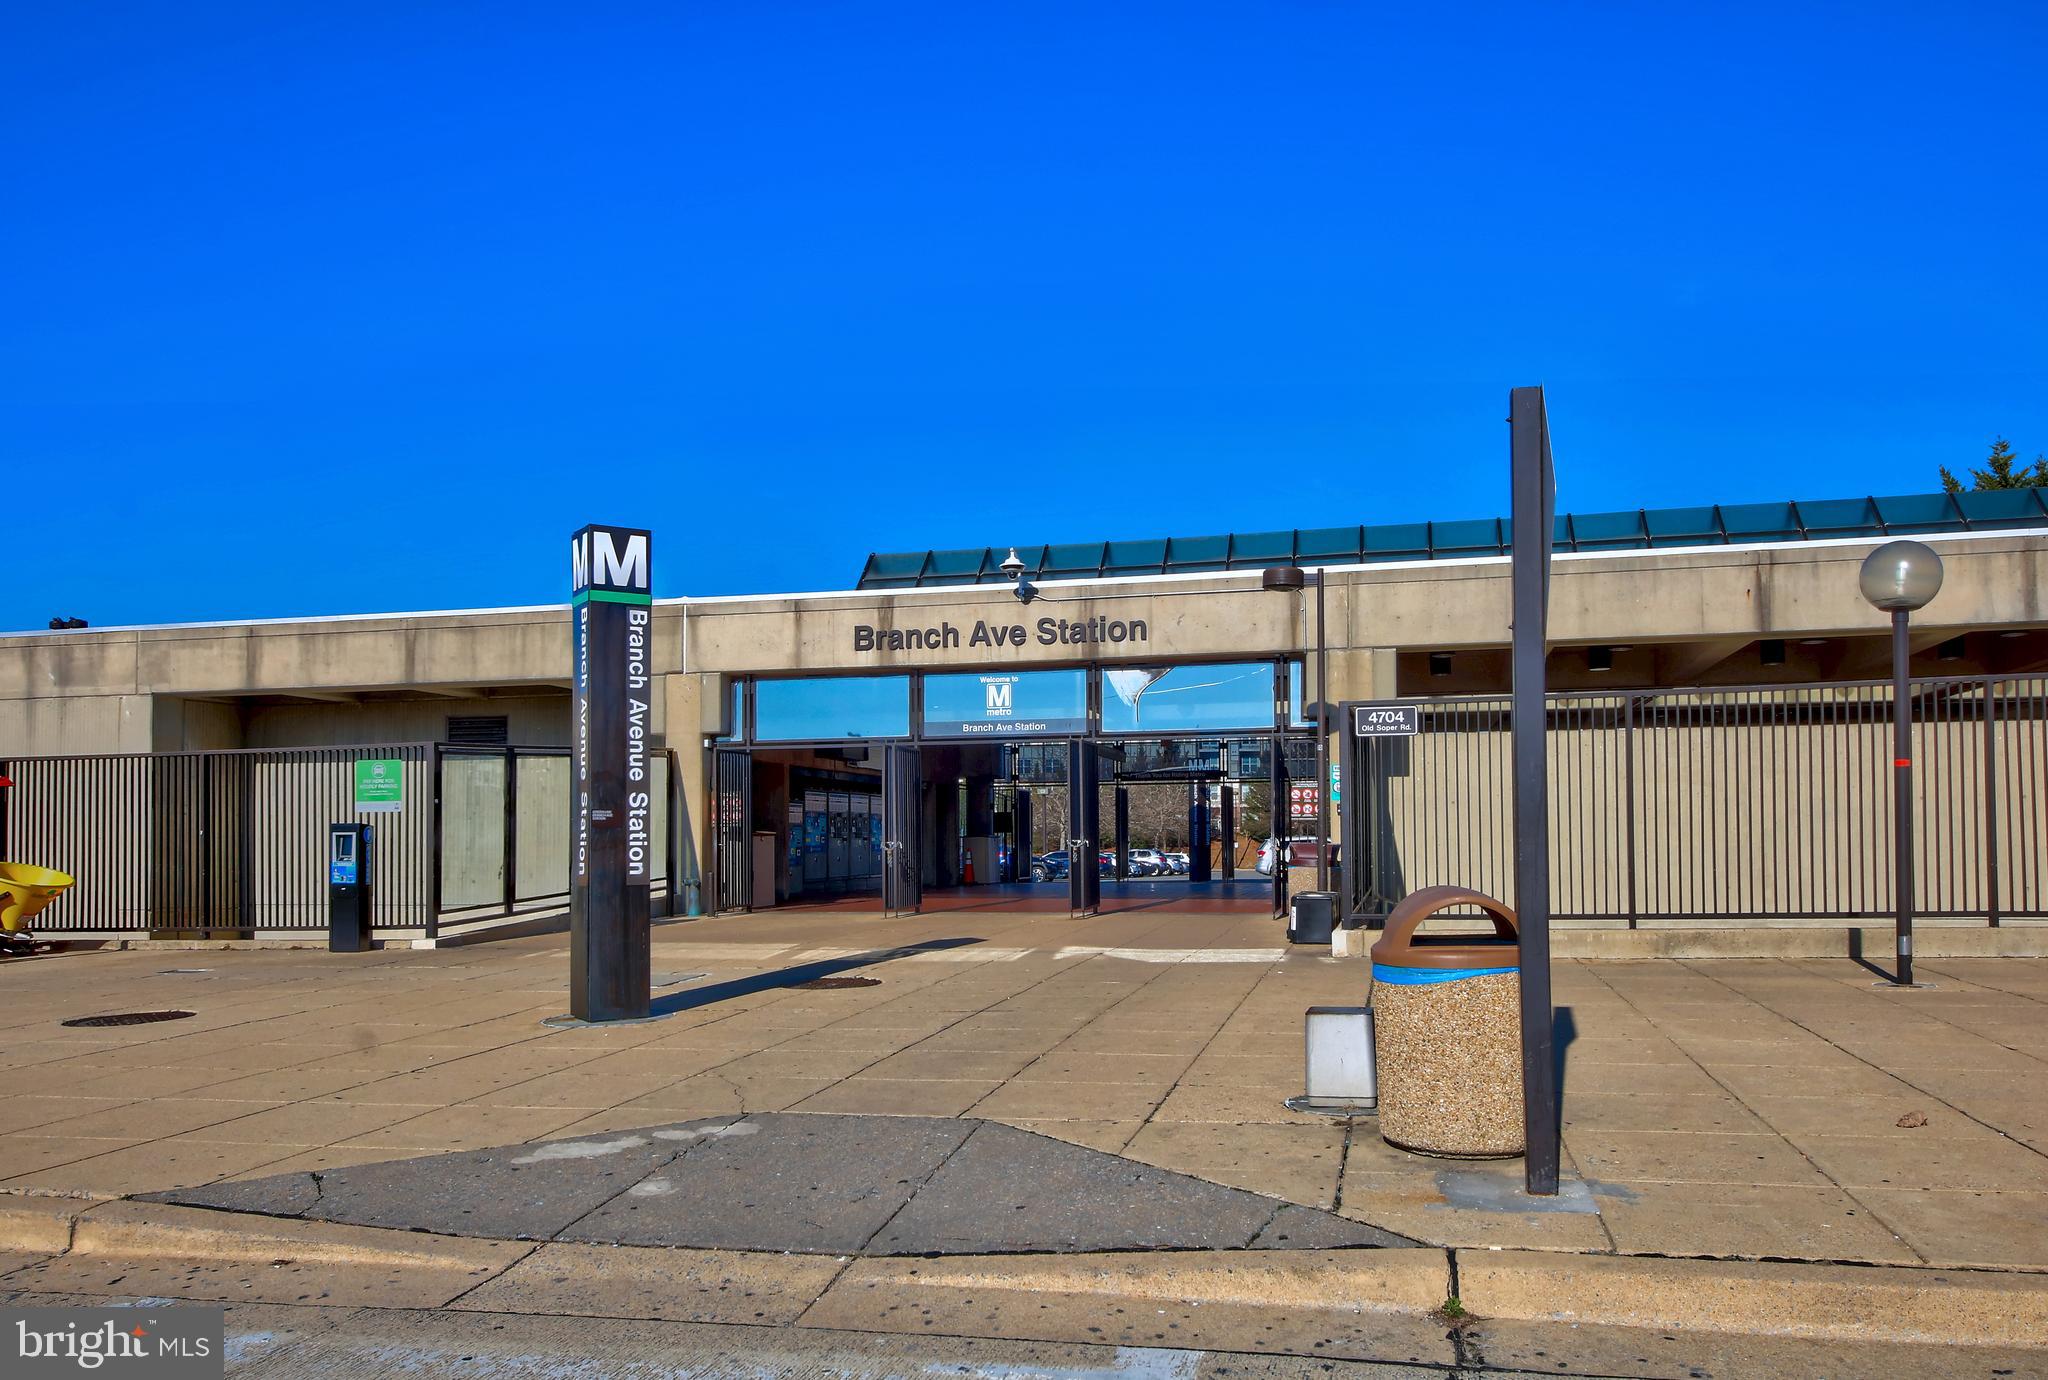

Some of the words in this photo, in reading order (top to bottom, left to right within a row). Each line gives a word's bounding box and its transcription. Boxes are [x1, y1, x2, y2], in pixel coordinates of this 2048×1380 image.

[572, 532, 589, 592] M
[593, 531, 648, 589] M
[580, 607, 589, 688] Branch
[629, 609, 649, 689] Branch
[854, 622, 959, 651] Branch
[968, 620, 1027, 647] Ave
[1036, 616, 1148, 646] Station
[986, 708, 1012, 716] metro
[988, 685, 1010, 707] M
[1368, 711, 1405, 723] 4704
[580, 699, 589, 781] Avenue
[629, 698, 648, 781] Avenue
[962, 722, 994, 732] Branch
[996, 722, 1013, 731] Ave
[1014, 722, 1046, 731] Station
[578, 792, 589, 875] Station
[628, 792, 649, 875] Station
